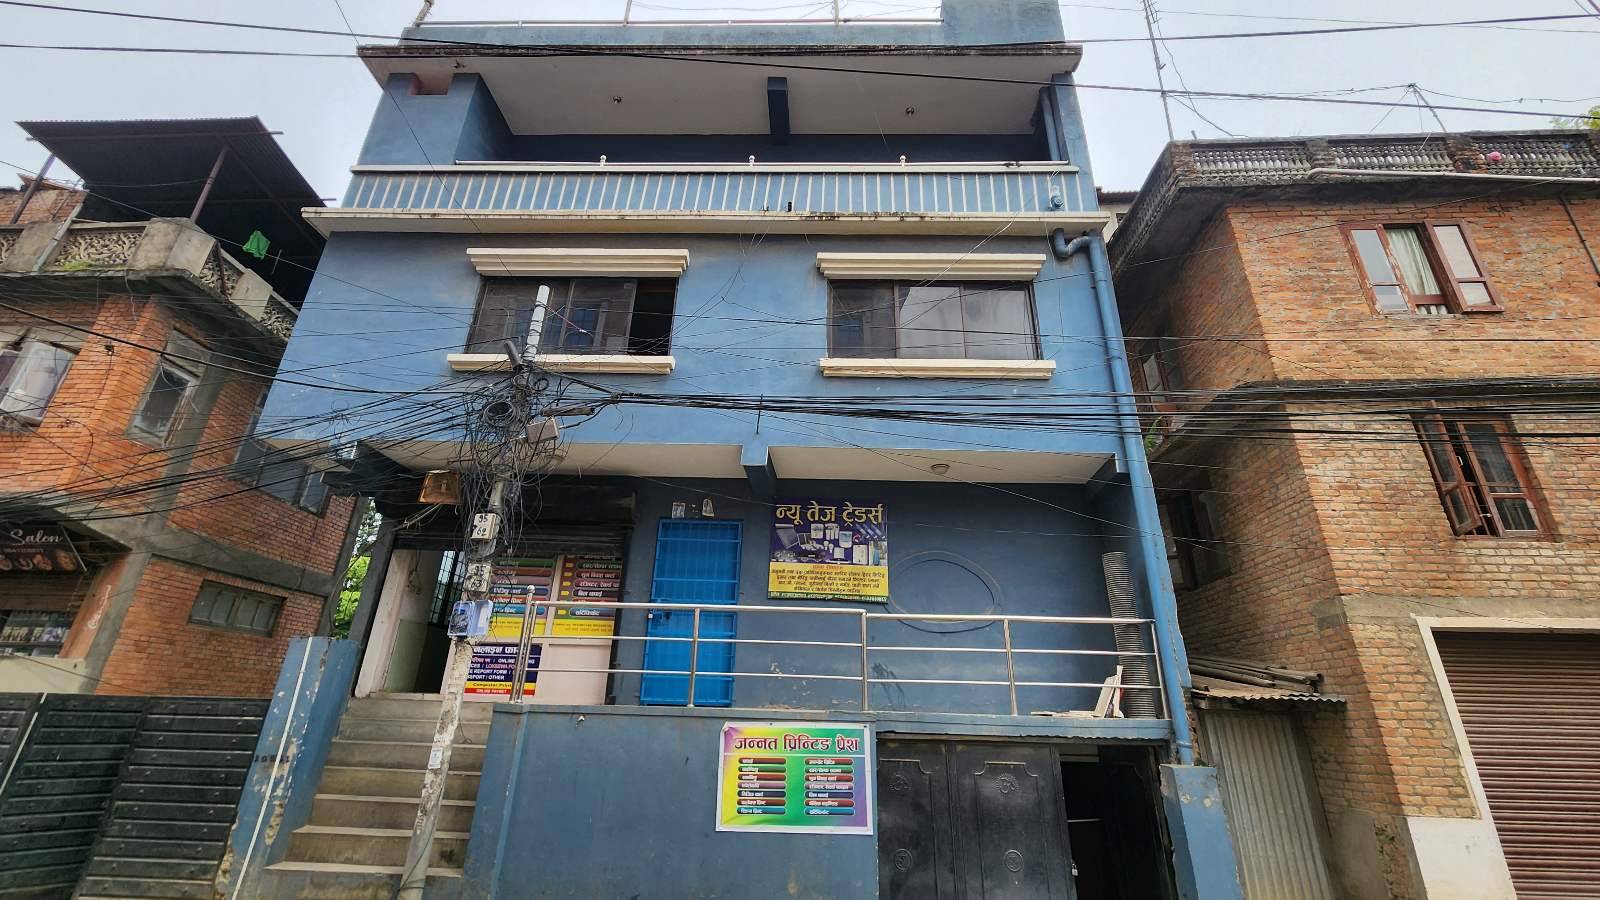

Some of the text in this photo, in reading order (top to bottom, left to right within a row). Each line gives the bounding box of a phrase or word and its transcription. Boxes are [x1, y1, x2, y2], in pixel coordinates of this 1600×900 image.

[776, 501, 884, 527] न्यू तेज ट्रेडर्स
[10, 528, 63, 546] Salon
[734, 736, 778, 750] जन्नत
[836, 734, 859, 753] प्रेश
